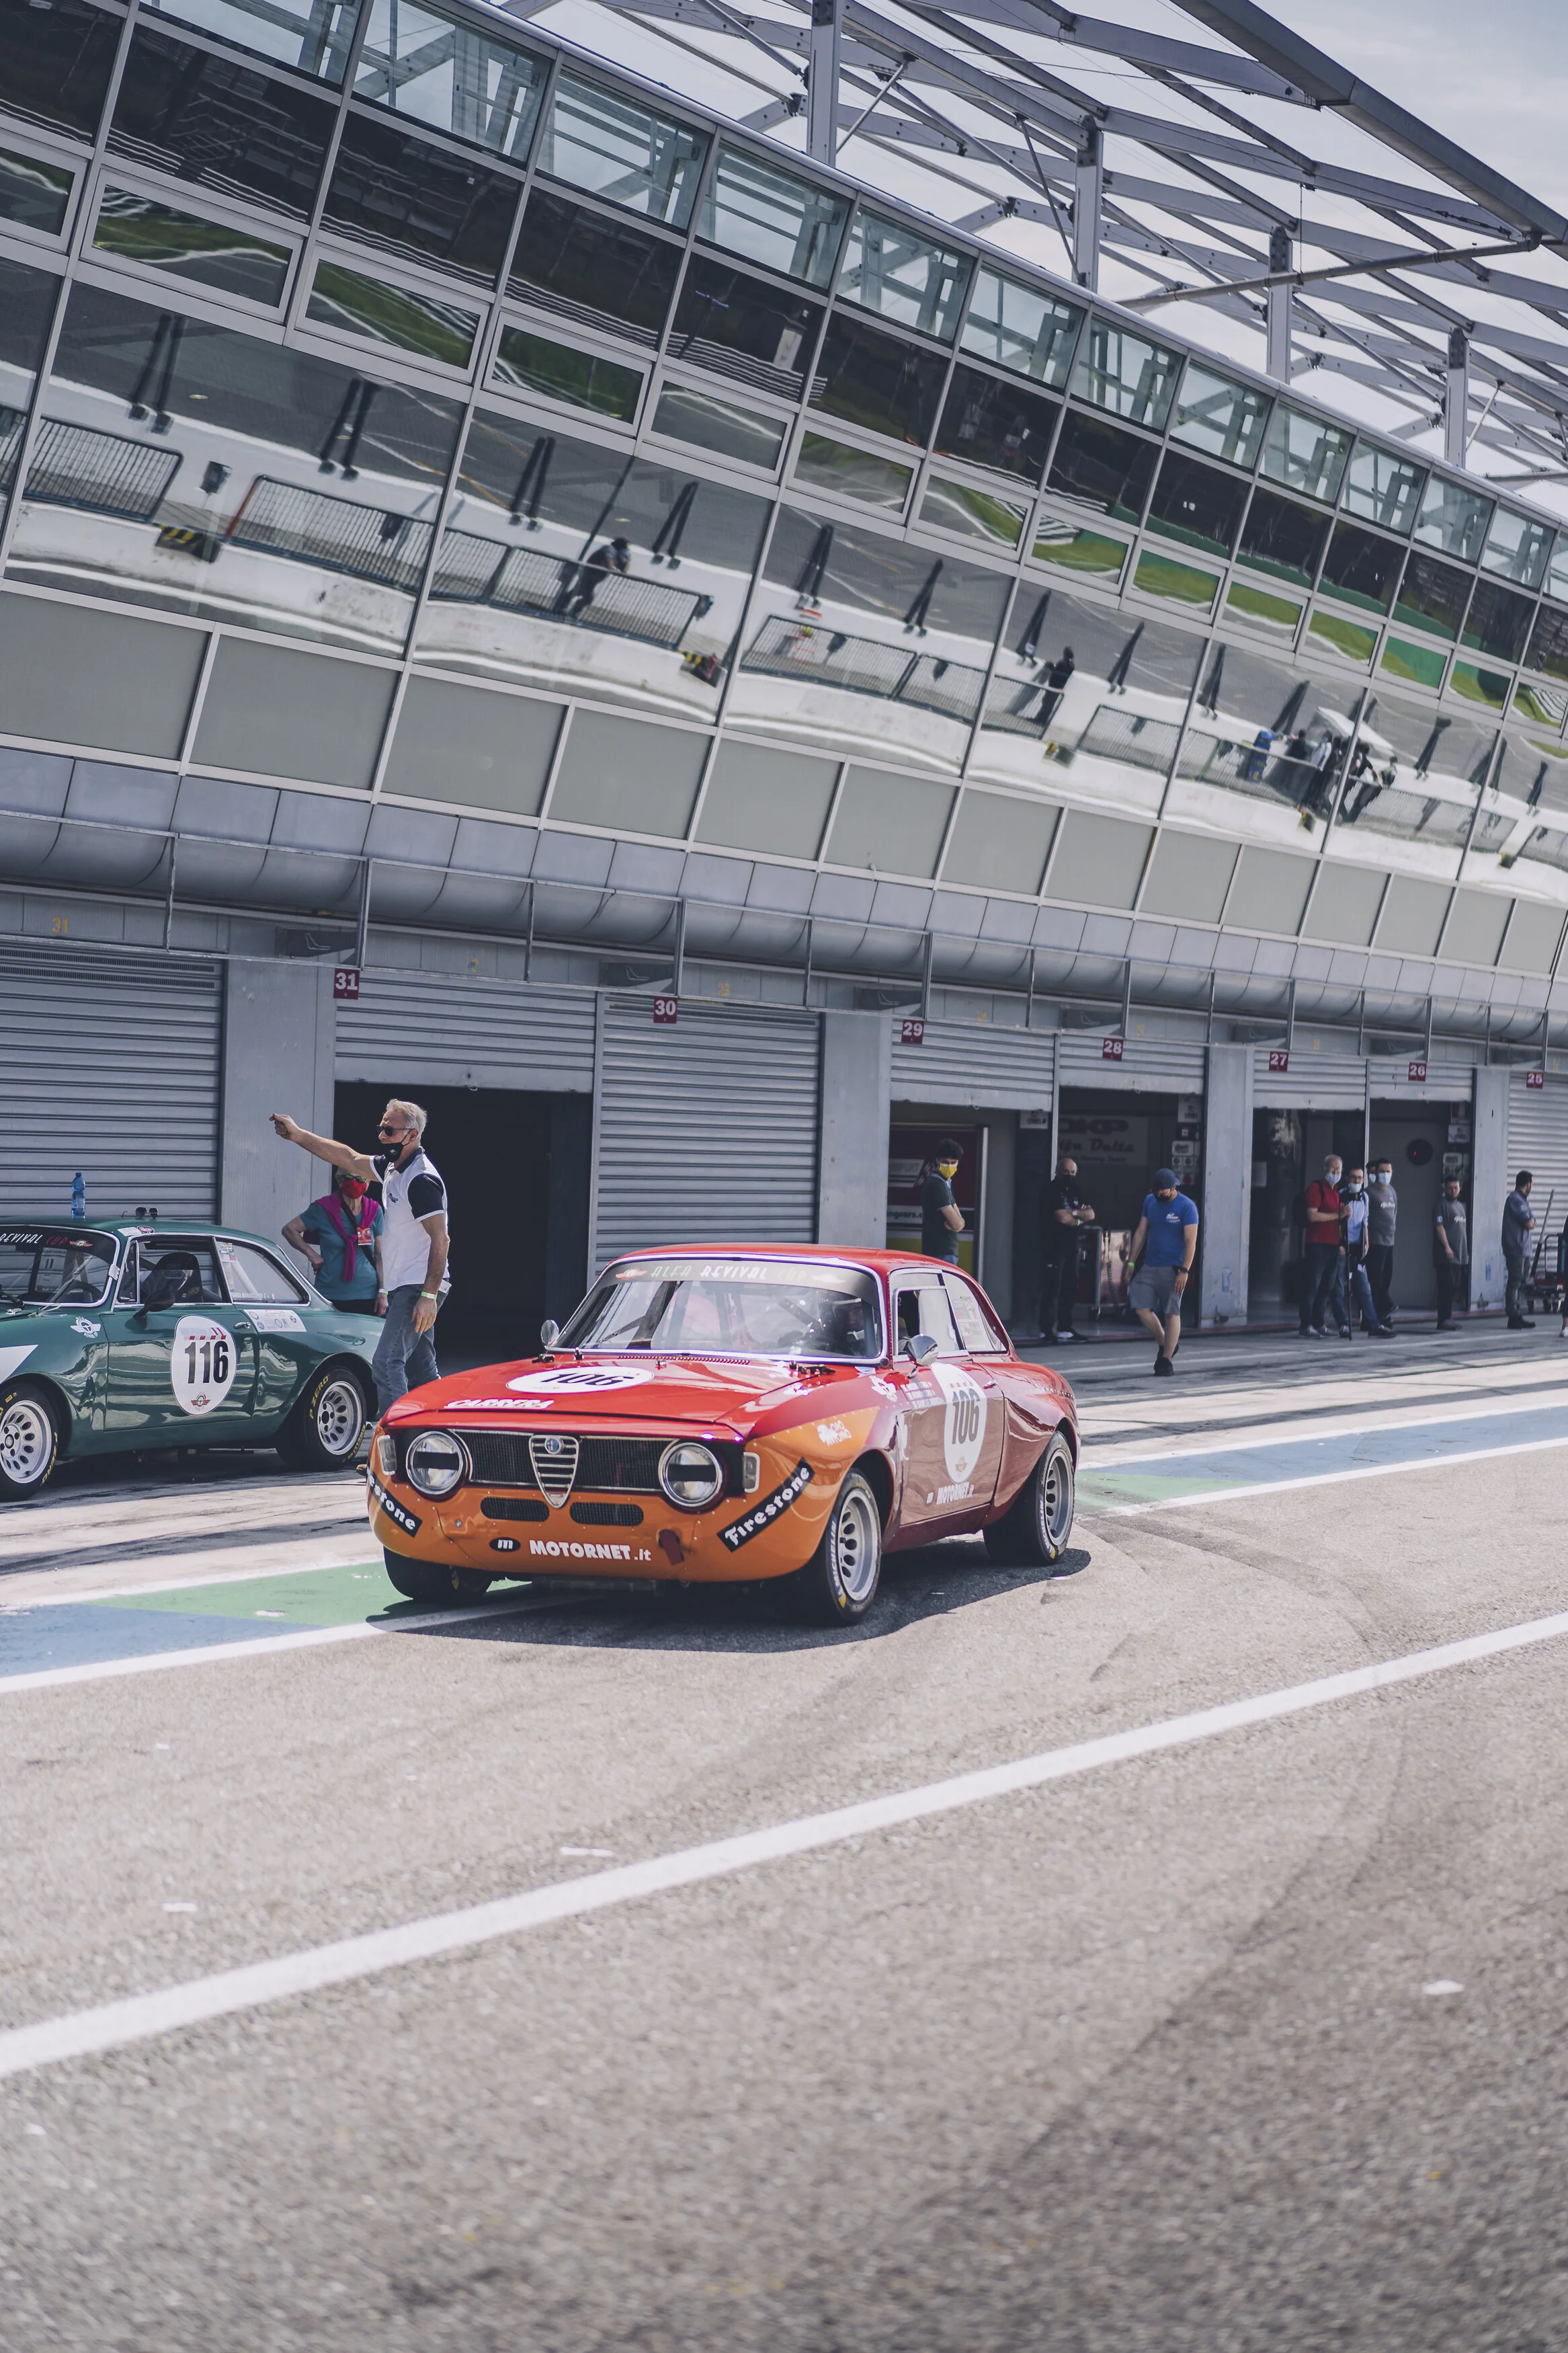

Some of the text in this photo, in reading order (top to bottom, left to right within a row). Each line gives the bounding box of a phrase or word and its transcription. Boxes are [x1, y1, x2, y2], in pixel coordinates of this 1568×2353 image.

[53, 916, 69, 934] 31
[335, 972, 358, 991] 31
[655, 1000, 676, 1016] 30
[903, 1022, 923, 1037] 29
[1104, 1040, 1122, 1054] 28
[1270, 1053, 1287, 1066] 27
[1409, 1065, 1426, 1076] 26
[1527, 1073, 1542, 1084] 25
[650, 1265, 693, 1277] ALFA
[700, 1265, 767, 1280] REVIVAL
[184, 1341, 229, 1384] 116
[540, 1372, 634, 1386] 106
[311, 1375, 329, 1407] ZERO
[952, 1388, 981, 1445] 106
[725, 1467, 810, 1546] Firestone
[830, 1521, 839, 1587] MICHELIN
